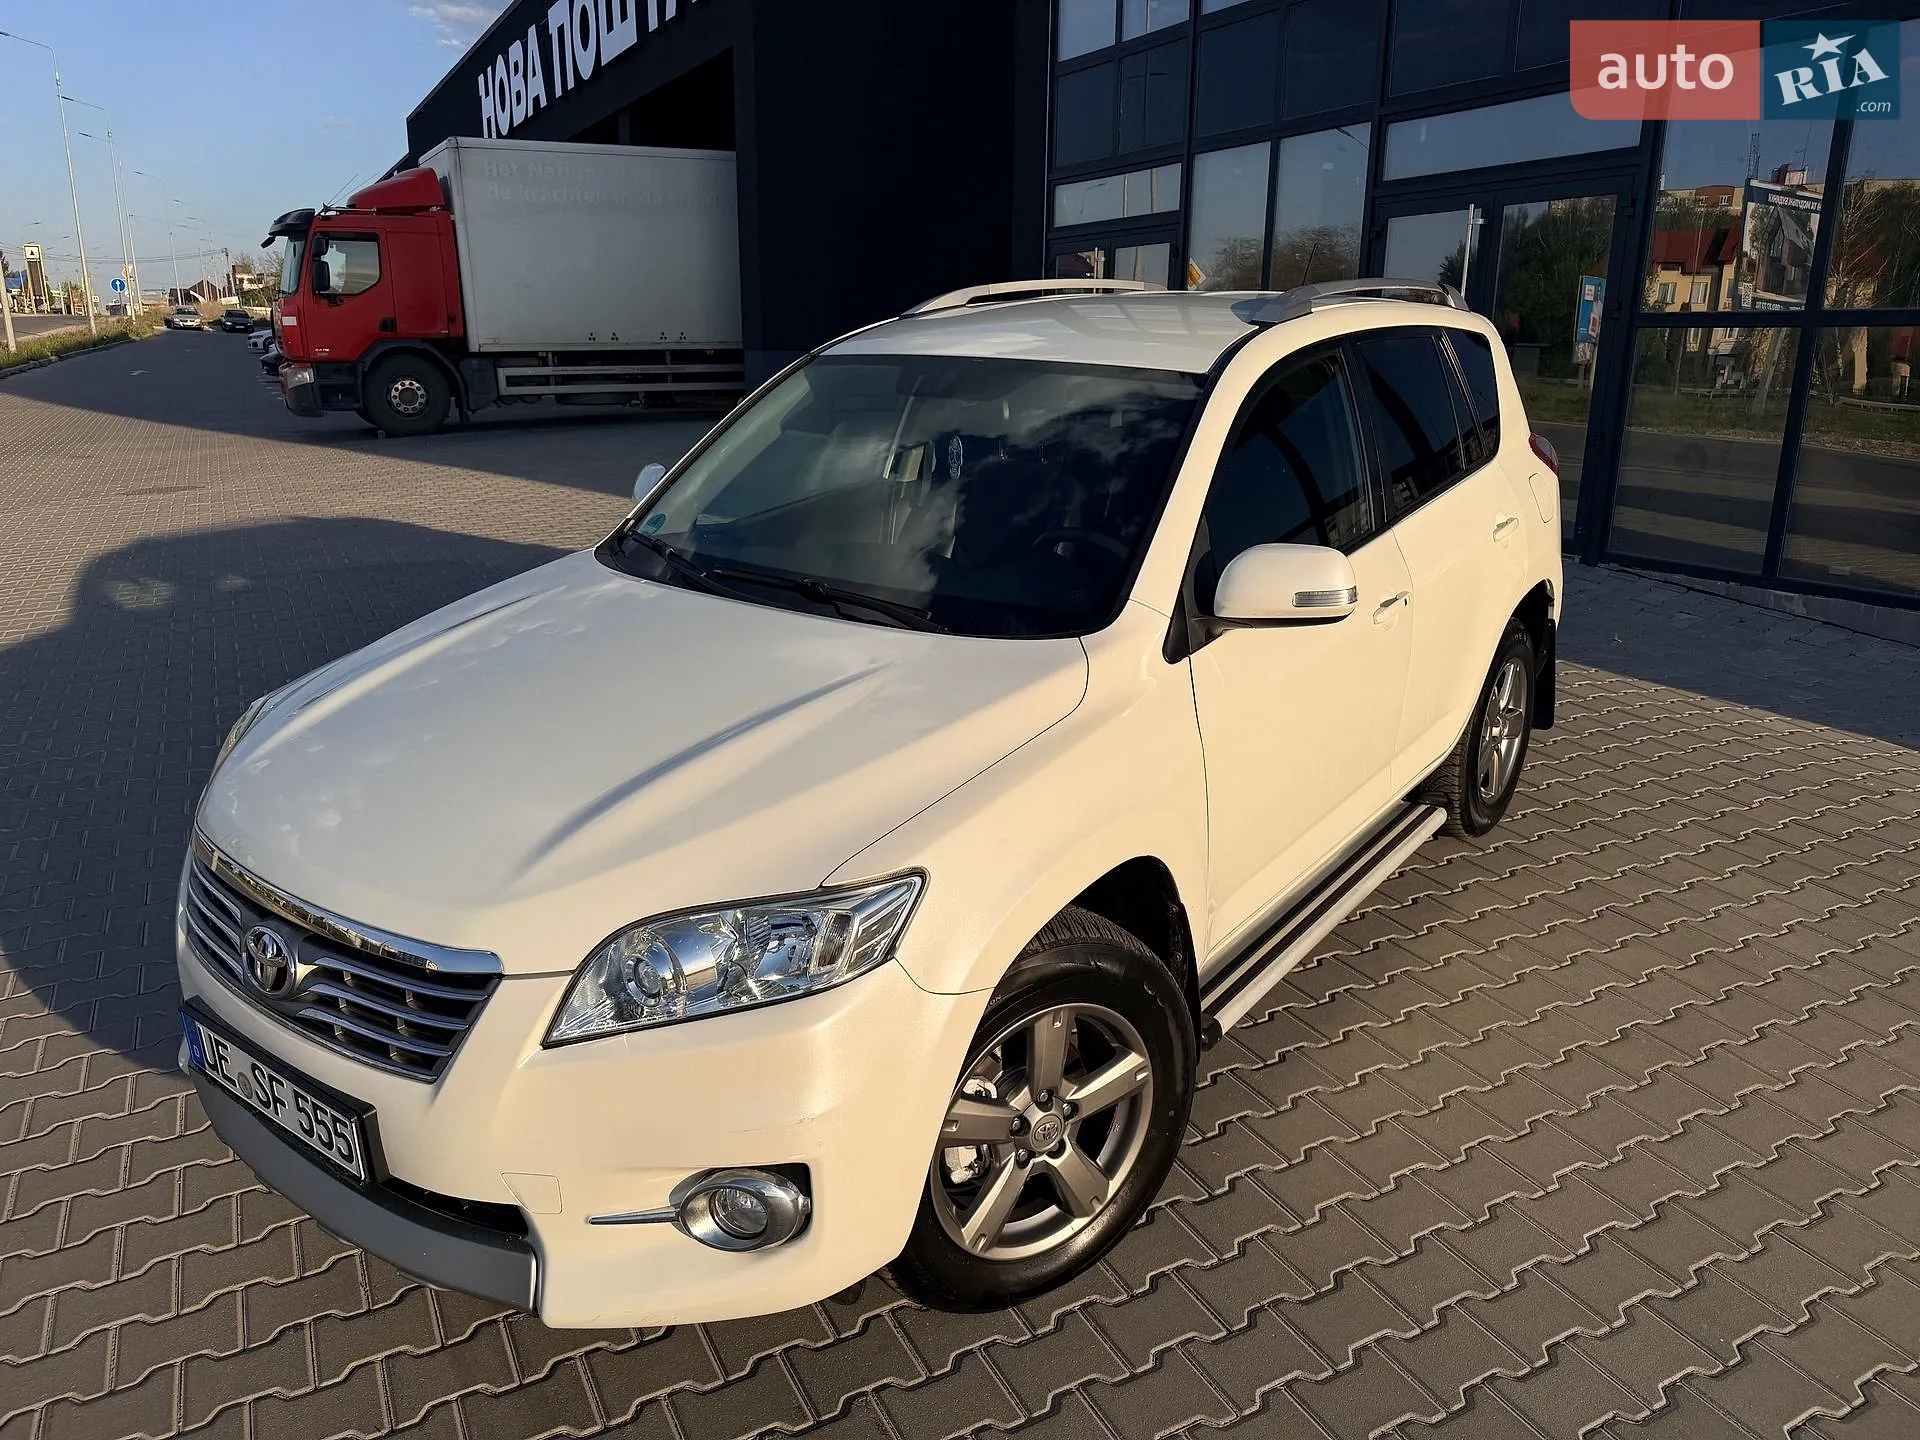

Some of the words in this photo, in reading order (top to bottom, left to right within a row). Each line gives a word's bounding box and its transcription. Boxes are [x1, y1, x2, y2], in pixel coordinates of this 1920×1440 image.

[478, 24, 548, 139] НОВА
[548, 0, 698, 99] ПОШ
[197, 1026, 239, 1089] UE
[251, 1062, 289, 1118] SF
[293, 1087, 356, 1166] 555
